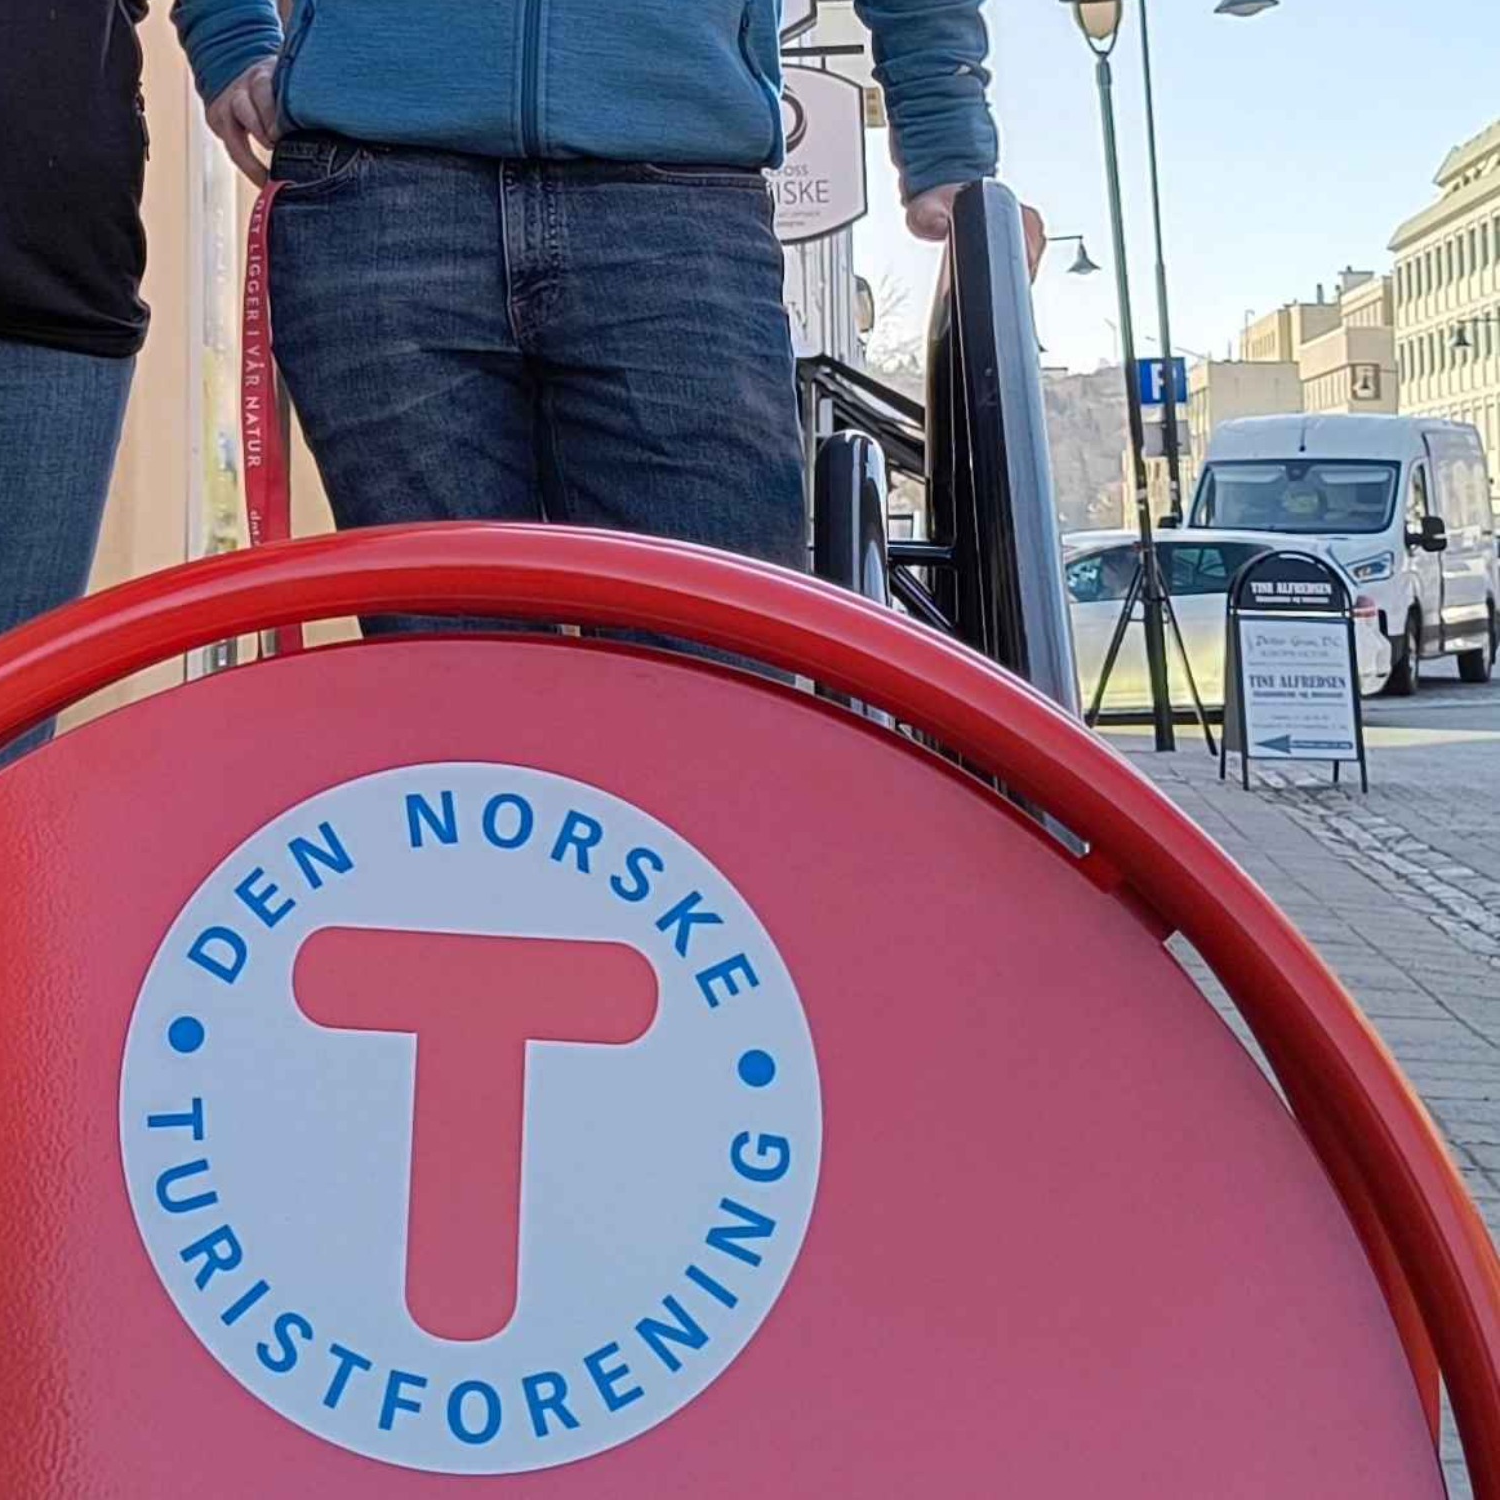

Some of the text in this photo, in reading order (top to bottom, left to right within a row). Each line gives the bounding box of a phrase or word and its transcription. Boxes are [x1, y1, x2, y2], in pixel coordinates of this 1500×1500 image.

[246, 243, 262, 321] LIGGER
[245, 346, 265, 388] VÅR
[245, 396, 261, 467] NATUR
[186, 790, 760, 1009] DEN NORSKE
[146, 1097, 791, 1445] TURISTFORENING
